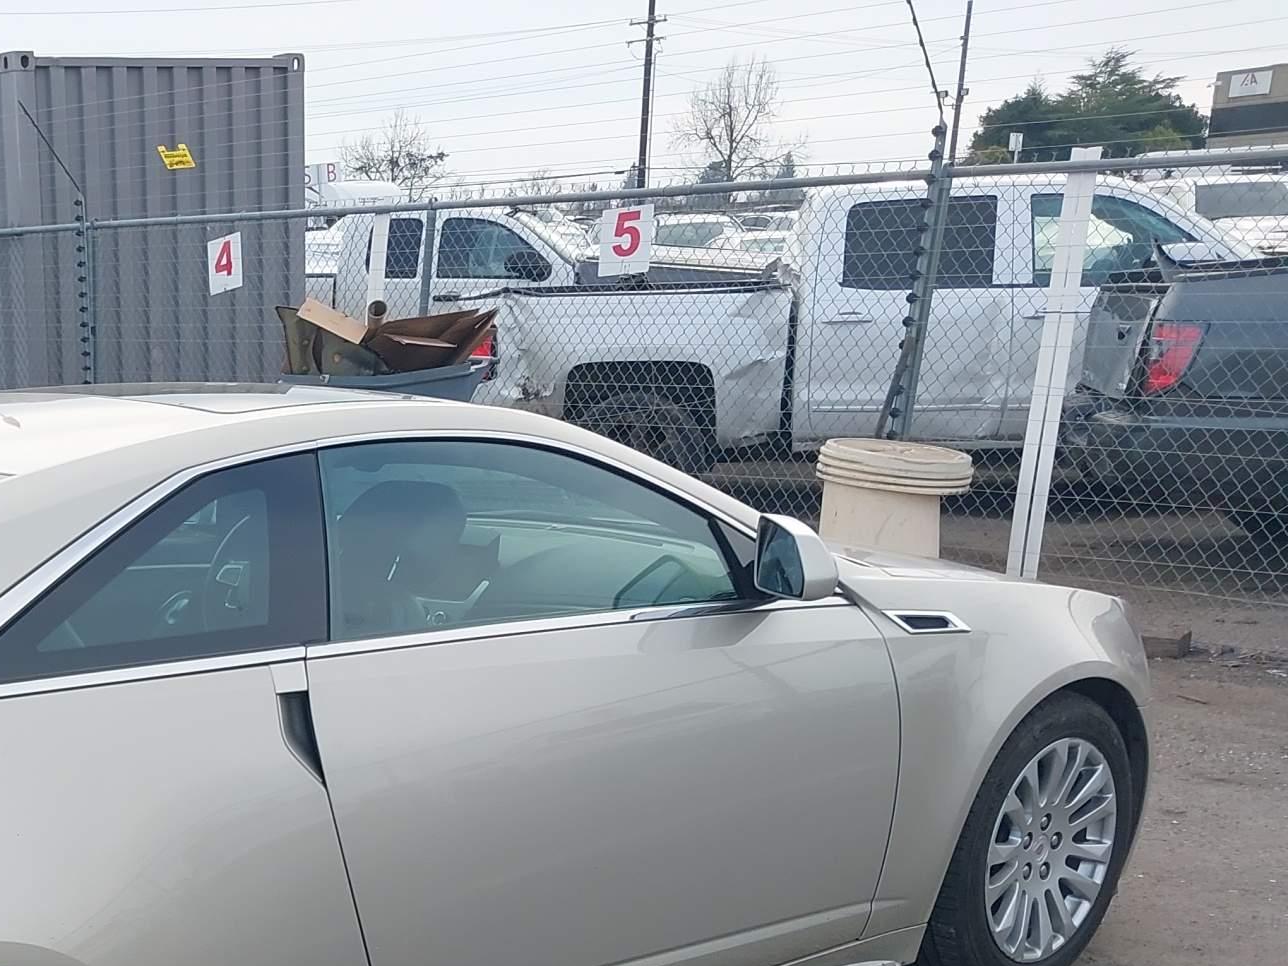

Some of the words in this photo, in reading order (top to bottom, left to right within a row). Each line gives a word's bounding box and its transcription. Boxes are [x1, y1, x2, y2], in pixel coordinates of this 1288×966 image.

[327, 163, 336, 182] B
[612, 210, 640, 257] 5
[215, 240, 232, 276] 4
